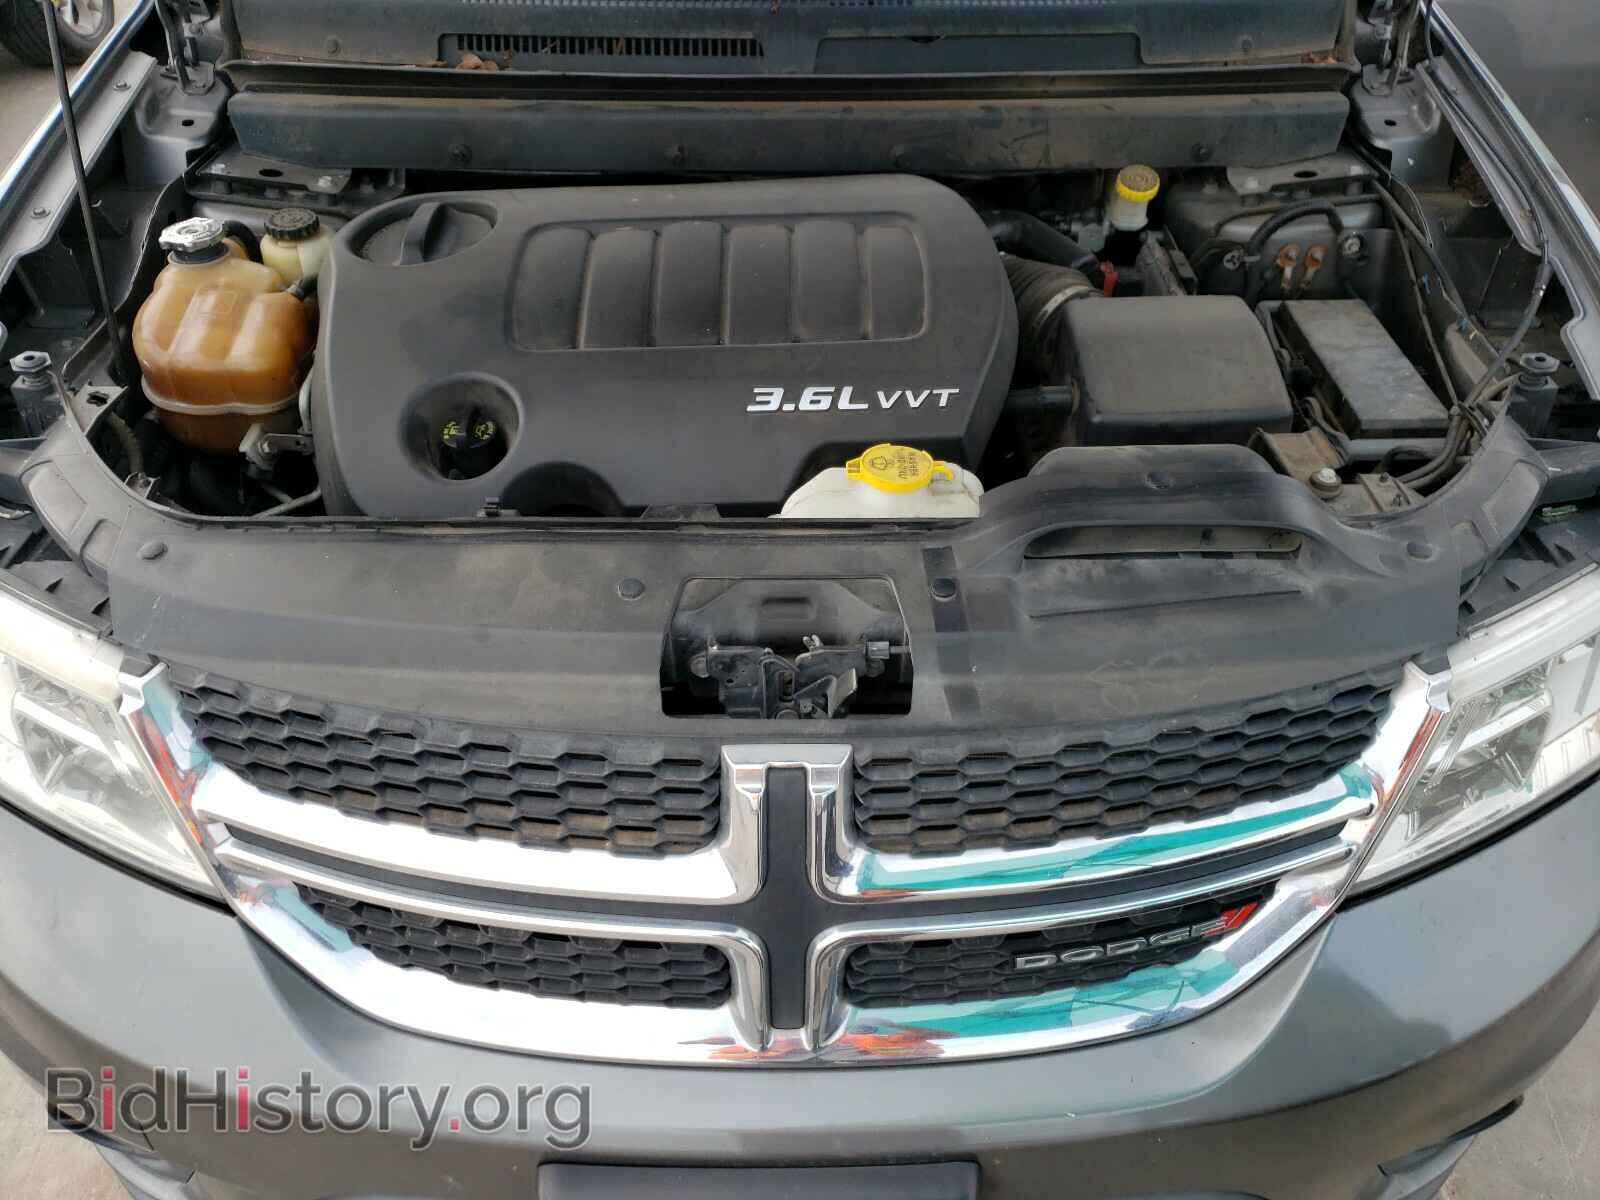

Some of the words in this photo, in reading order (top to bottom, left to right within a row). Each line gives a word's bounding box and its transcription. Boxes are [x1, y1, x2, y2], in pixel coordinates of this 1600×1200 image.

[746, 386, 869, 412] 3.6L
[876, 388, 960, 409] VVT
[1014, 918, 1230, 969] DODGE
